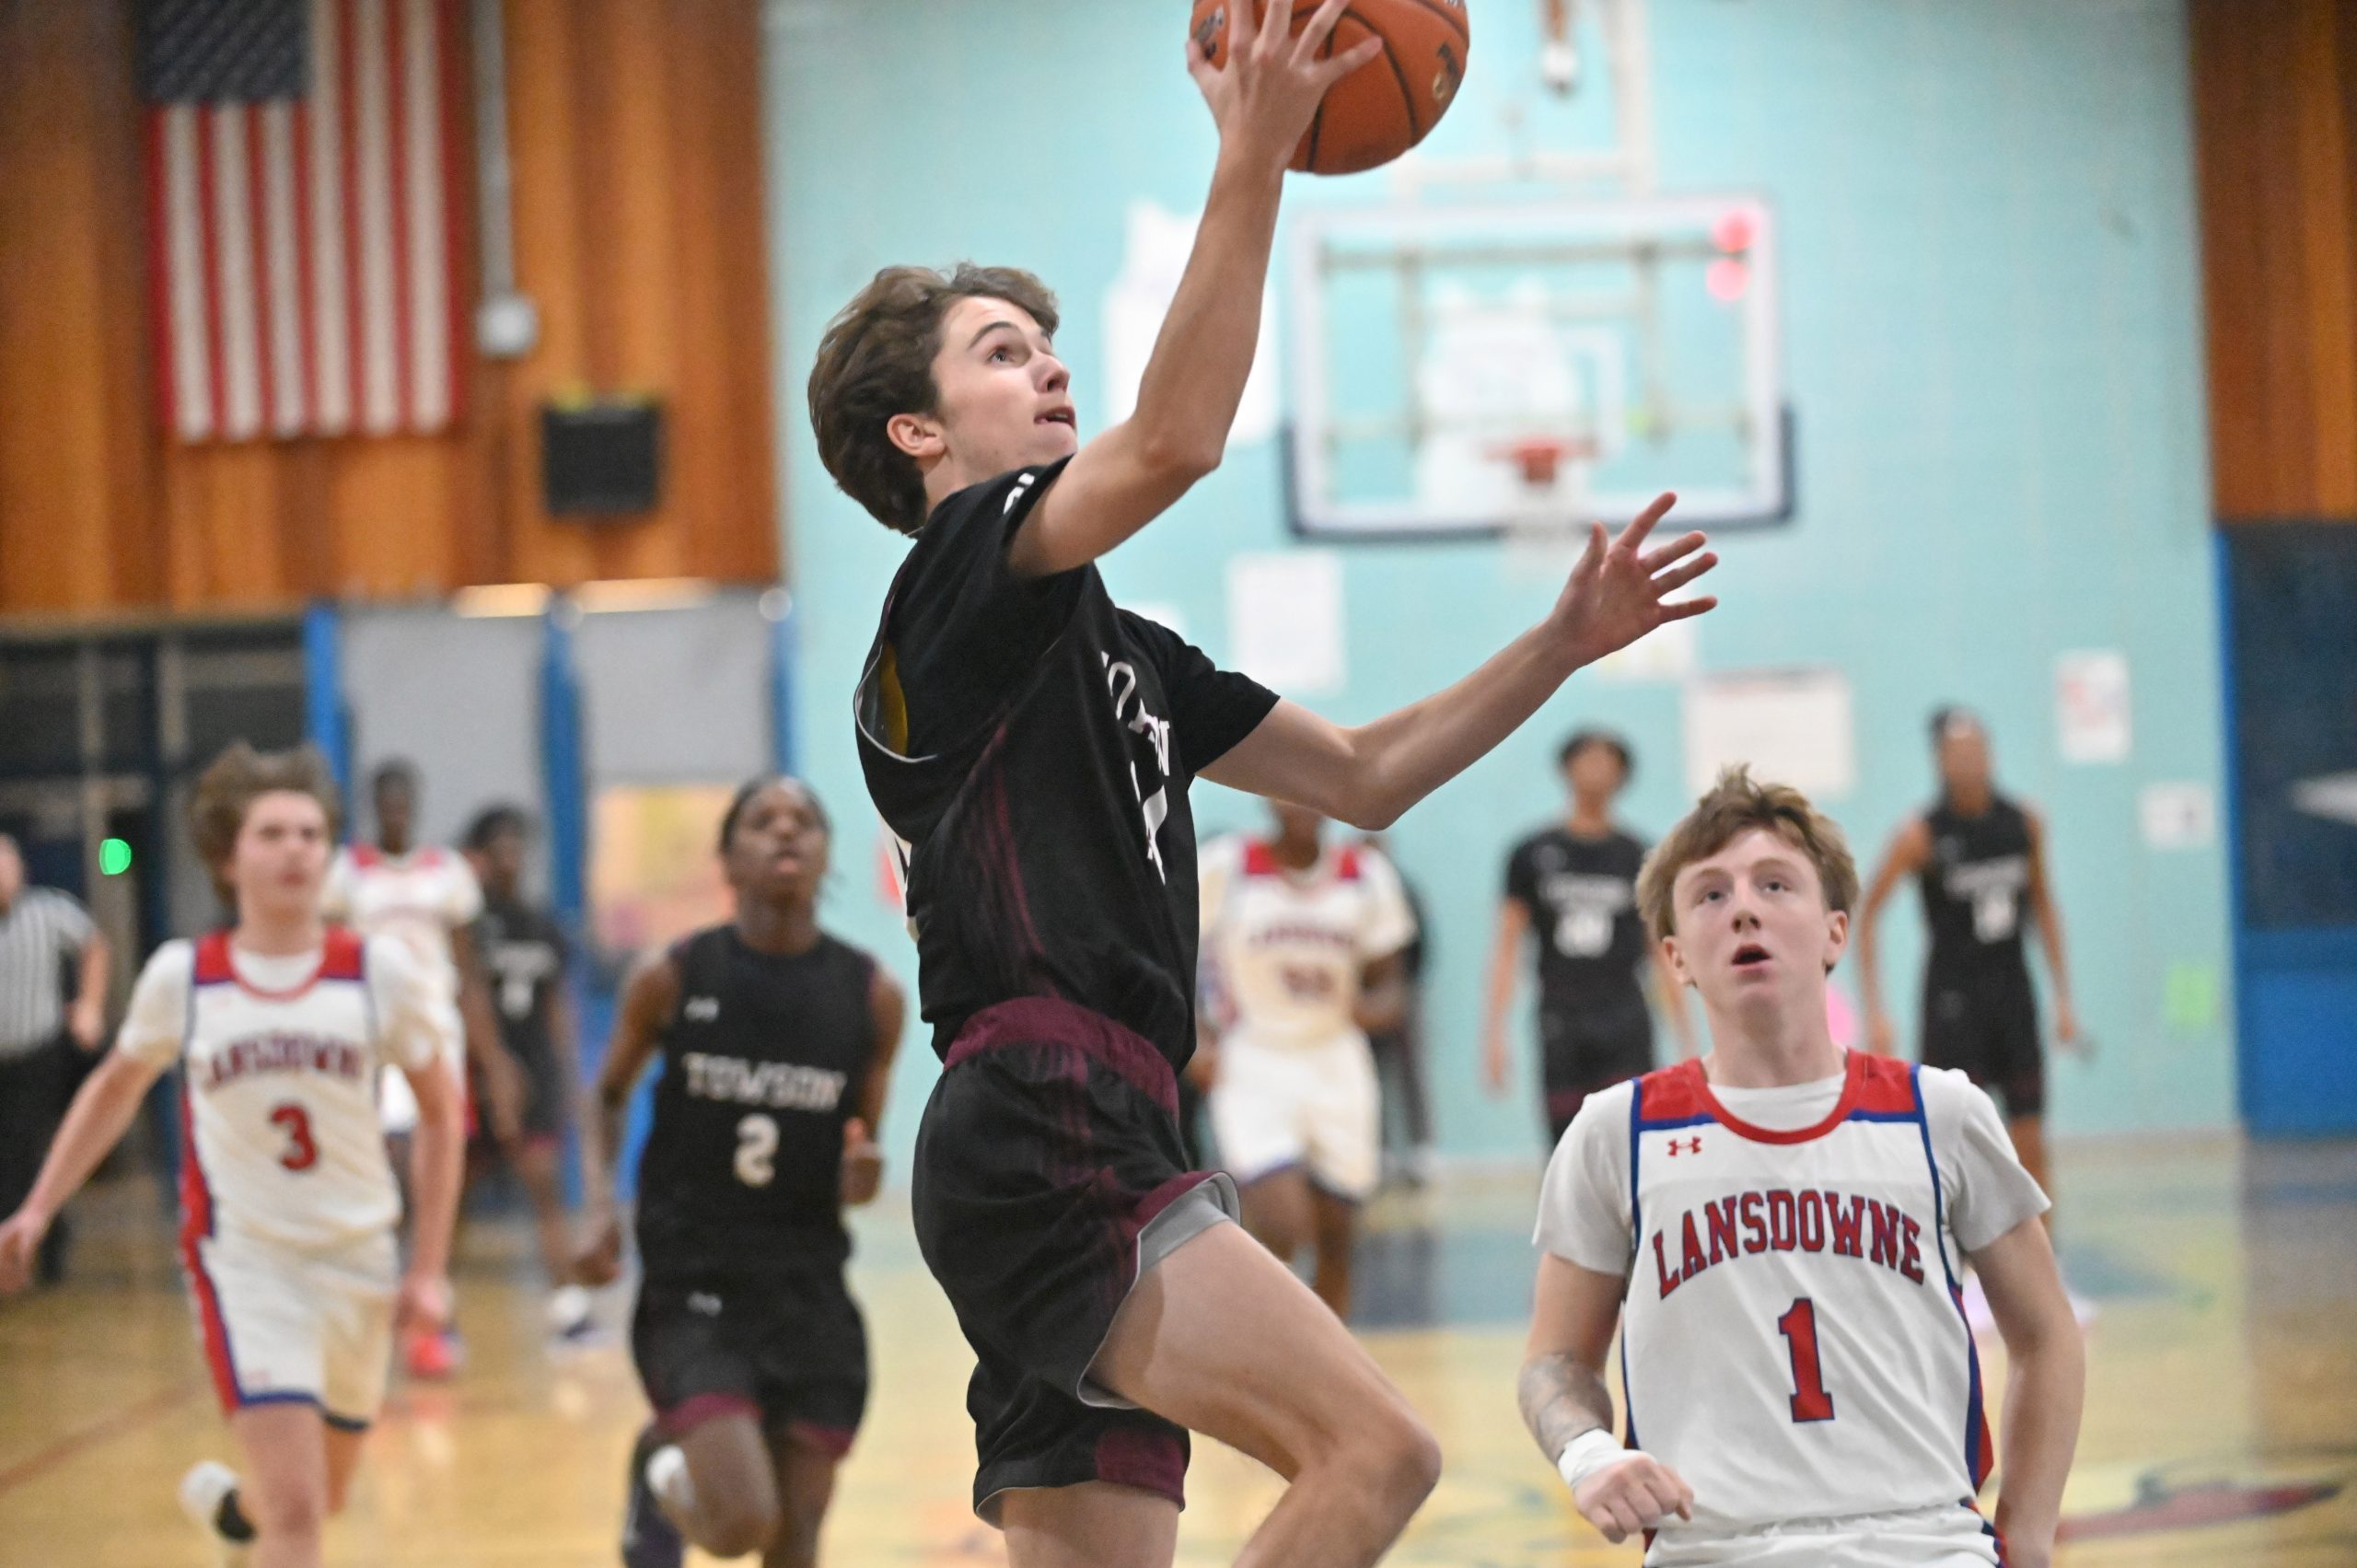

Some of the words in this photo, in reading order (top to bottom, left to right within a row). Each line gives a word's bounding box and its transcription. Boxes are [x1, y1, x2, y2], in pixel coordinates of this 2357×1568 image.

[682, 1052, 847, 1111] TOWSON
[271, 1102, 317, 1171] 3
[734, 1114, 780, 1187] 2
[1652, 1189, 1925, 1300] LANSDOWNE
[1778, 1297, 1836, 1423] 1
